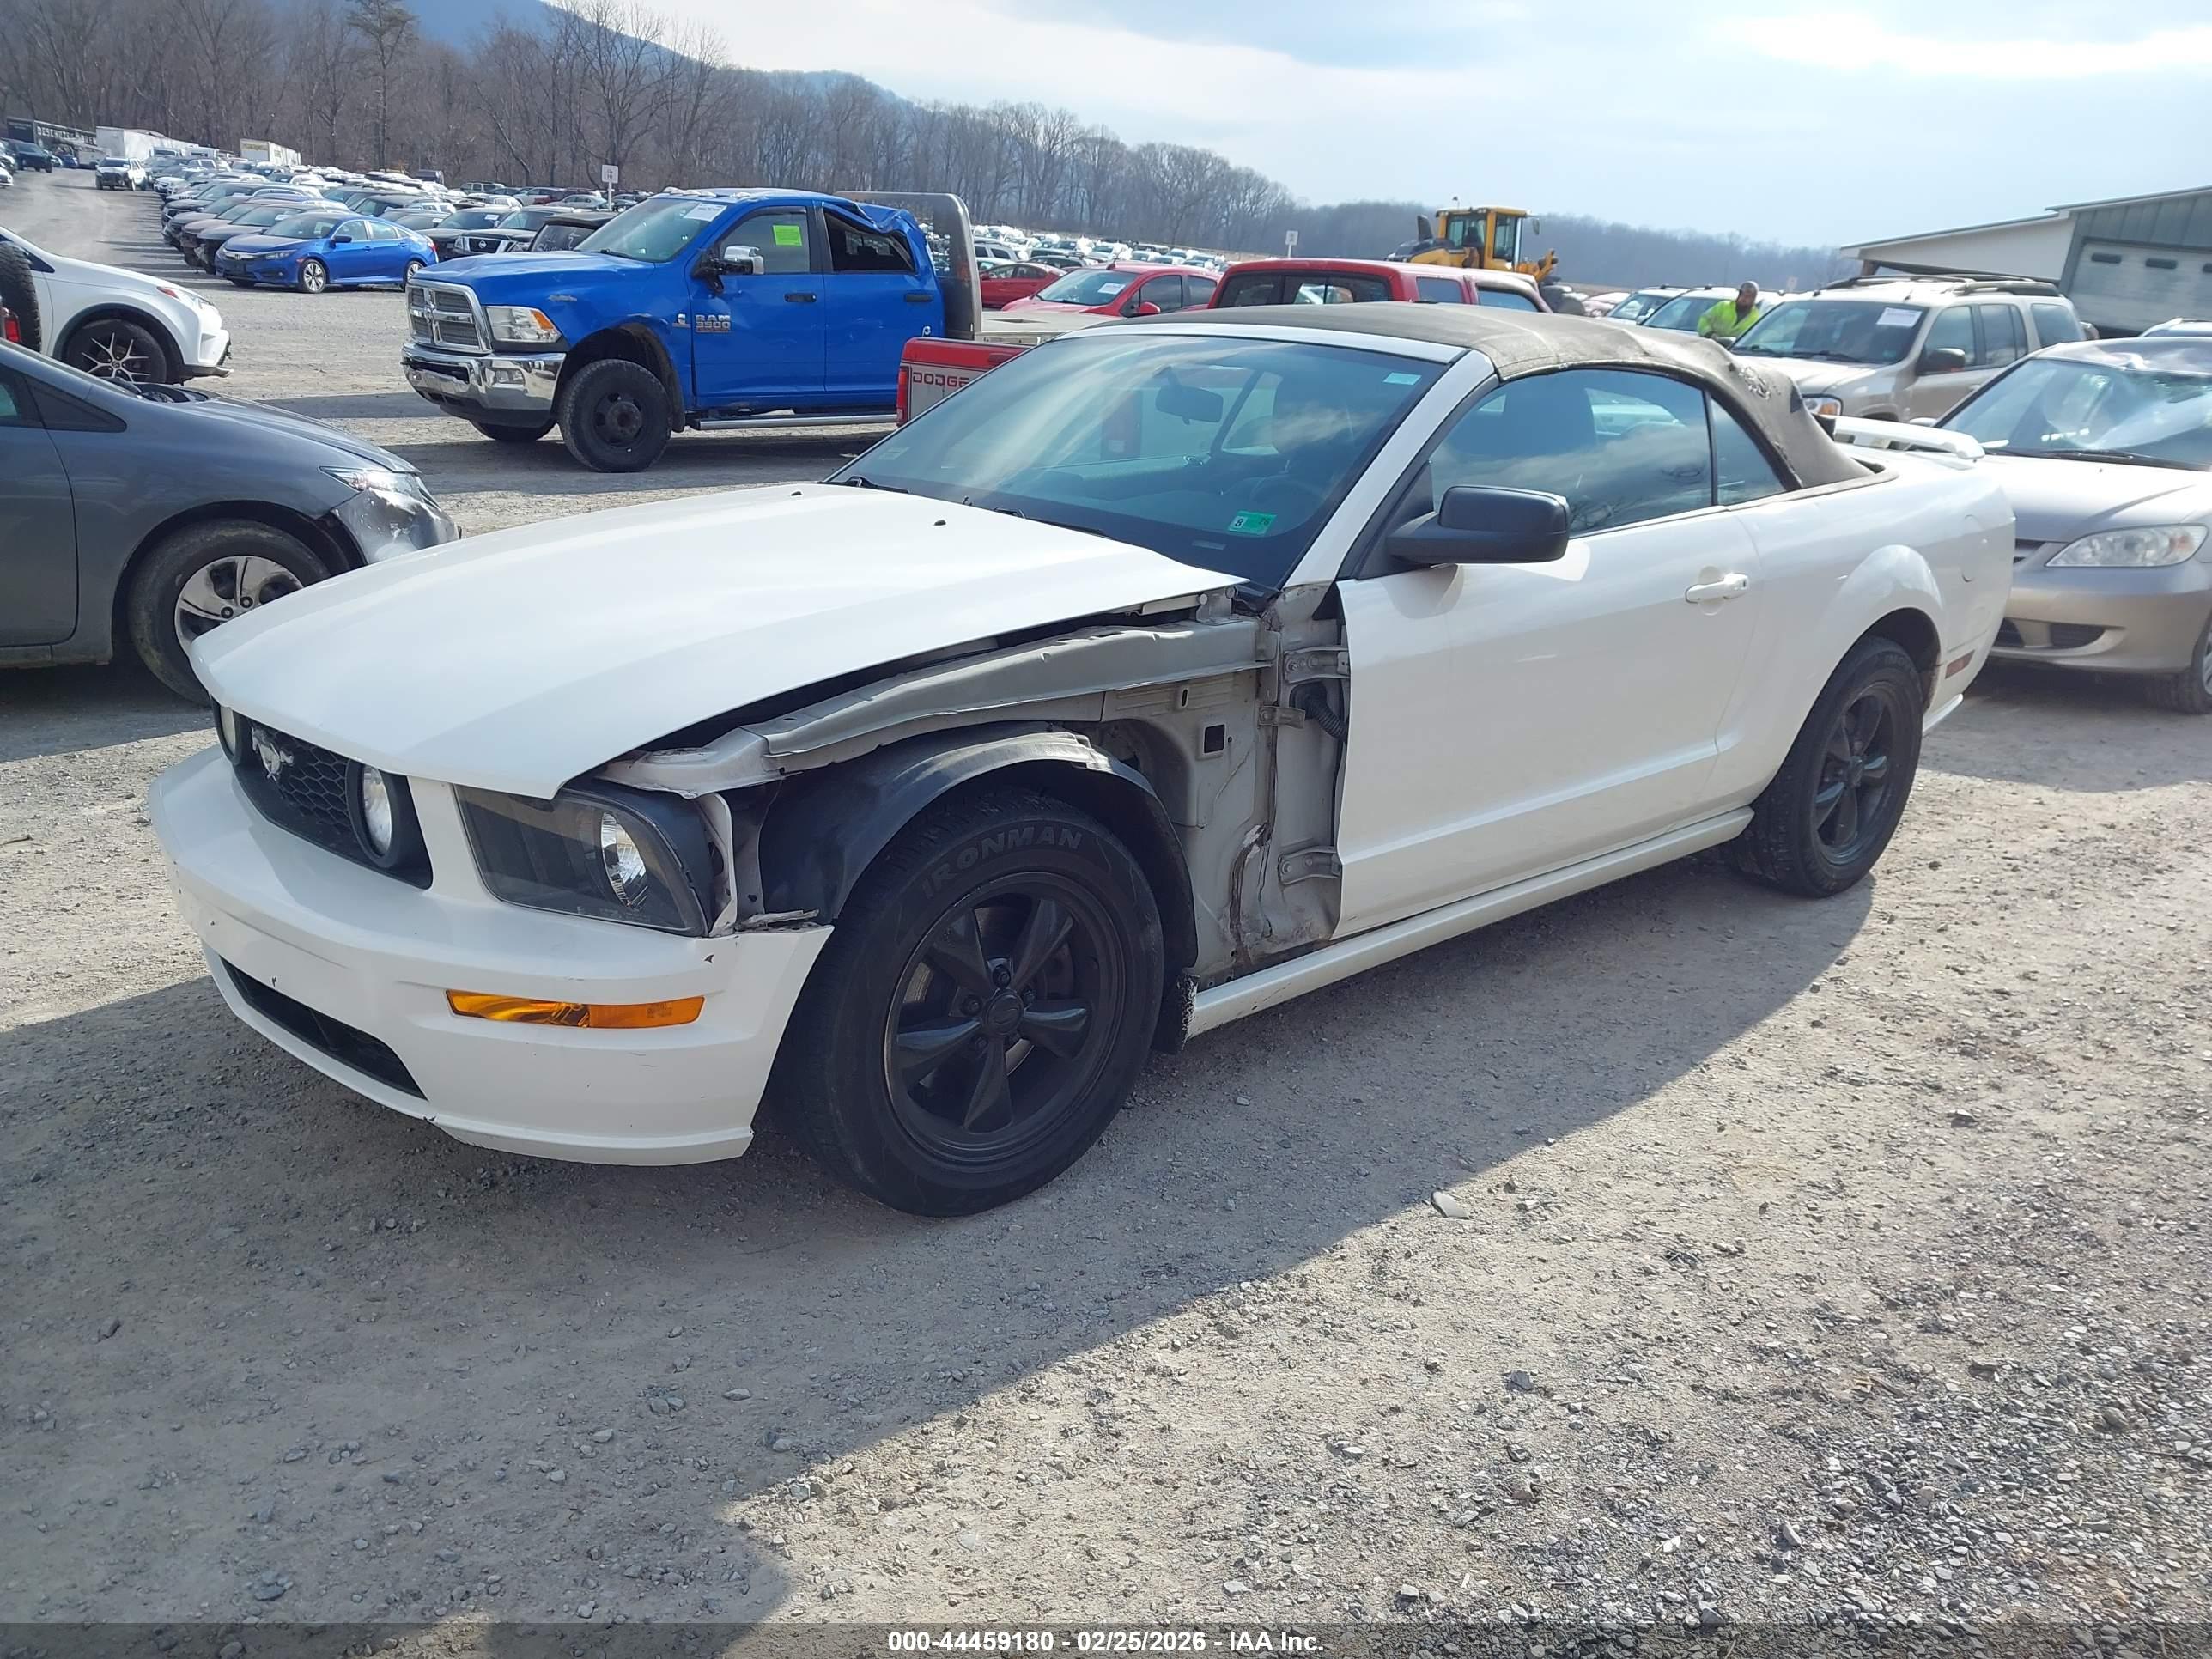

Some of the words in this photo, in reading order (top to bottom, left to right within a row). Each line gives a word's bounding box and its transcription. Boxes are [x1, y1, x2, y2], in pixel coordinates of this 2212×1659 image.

[696, 321, 731, 330] 3500
[913, 372, 970, 387] DODGE
[1235, 518, 1244, 527] 8
[923, 826, 1082, 900] IRONMAN
